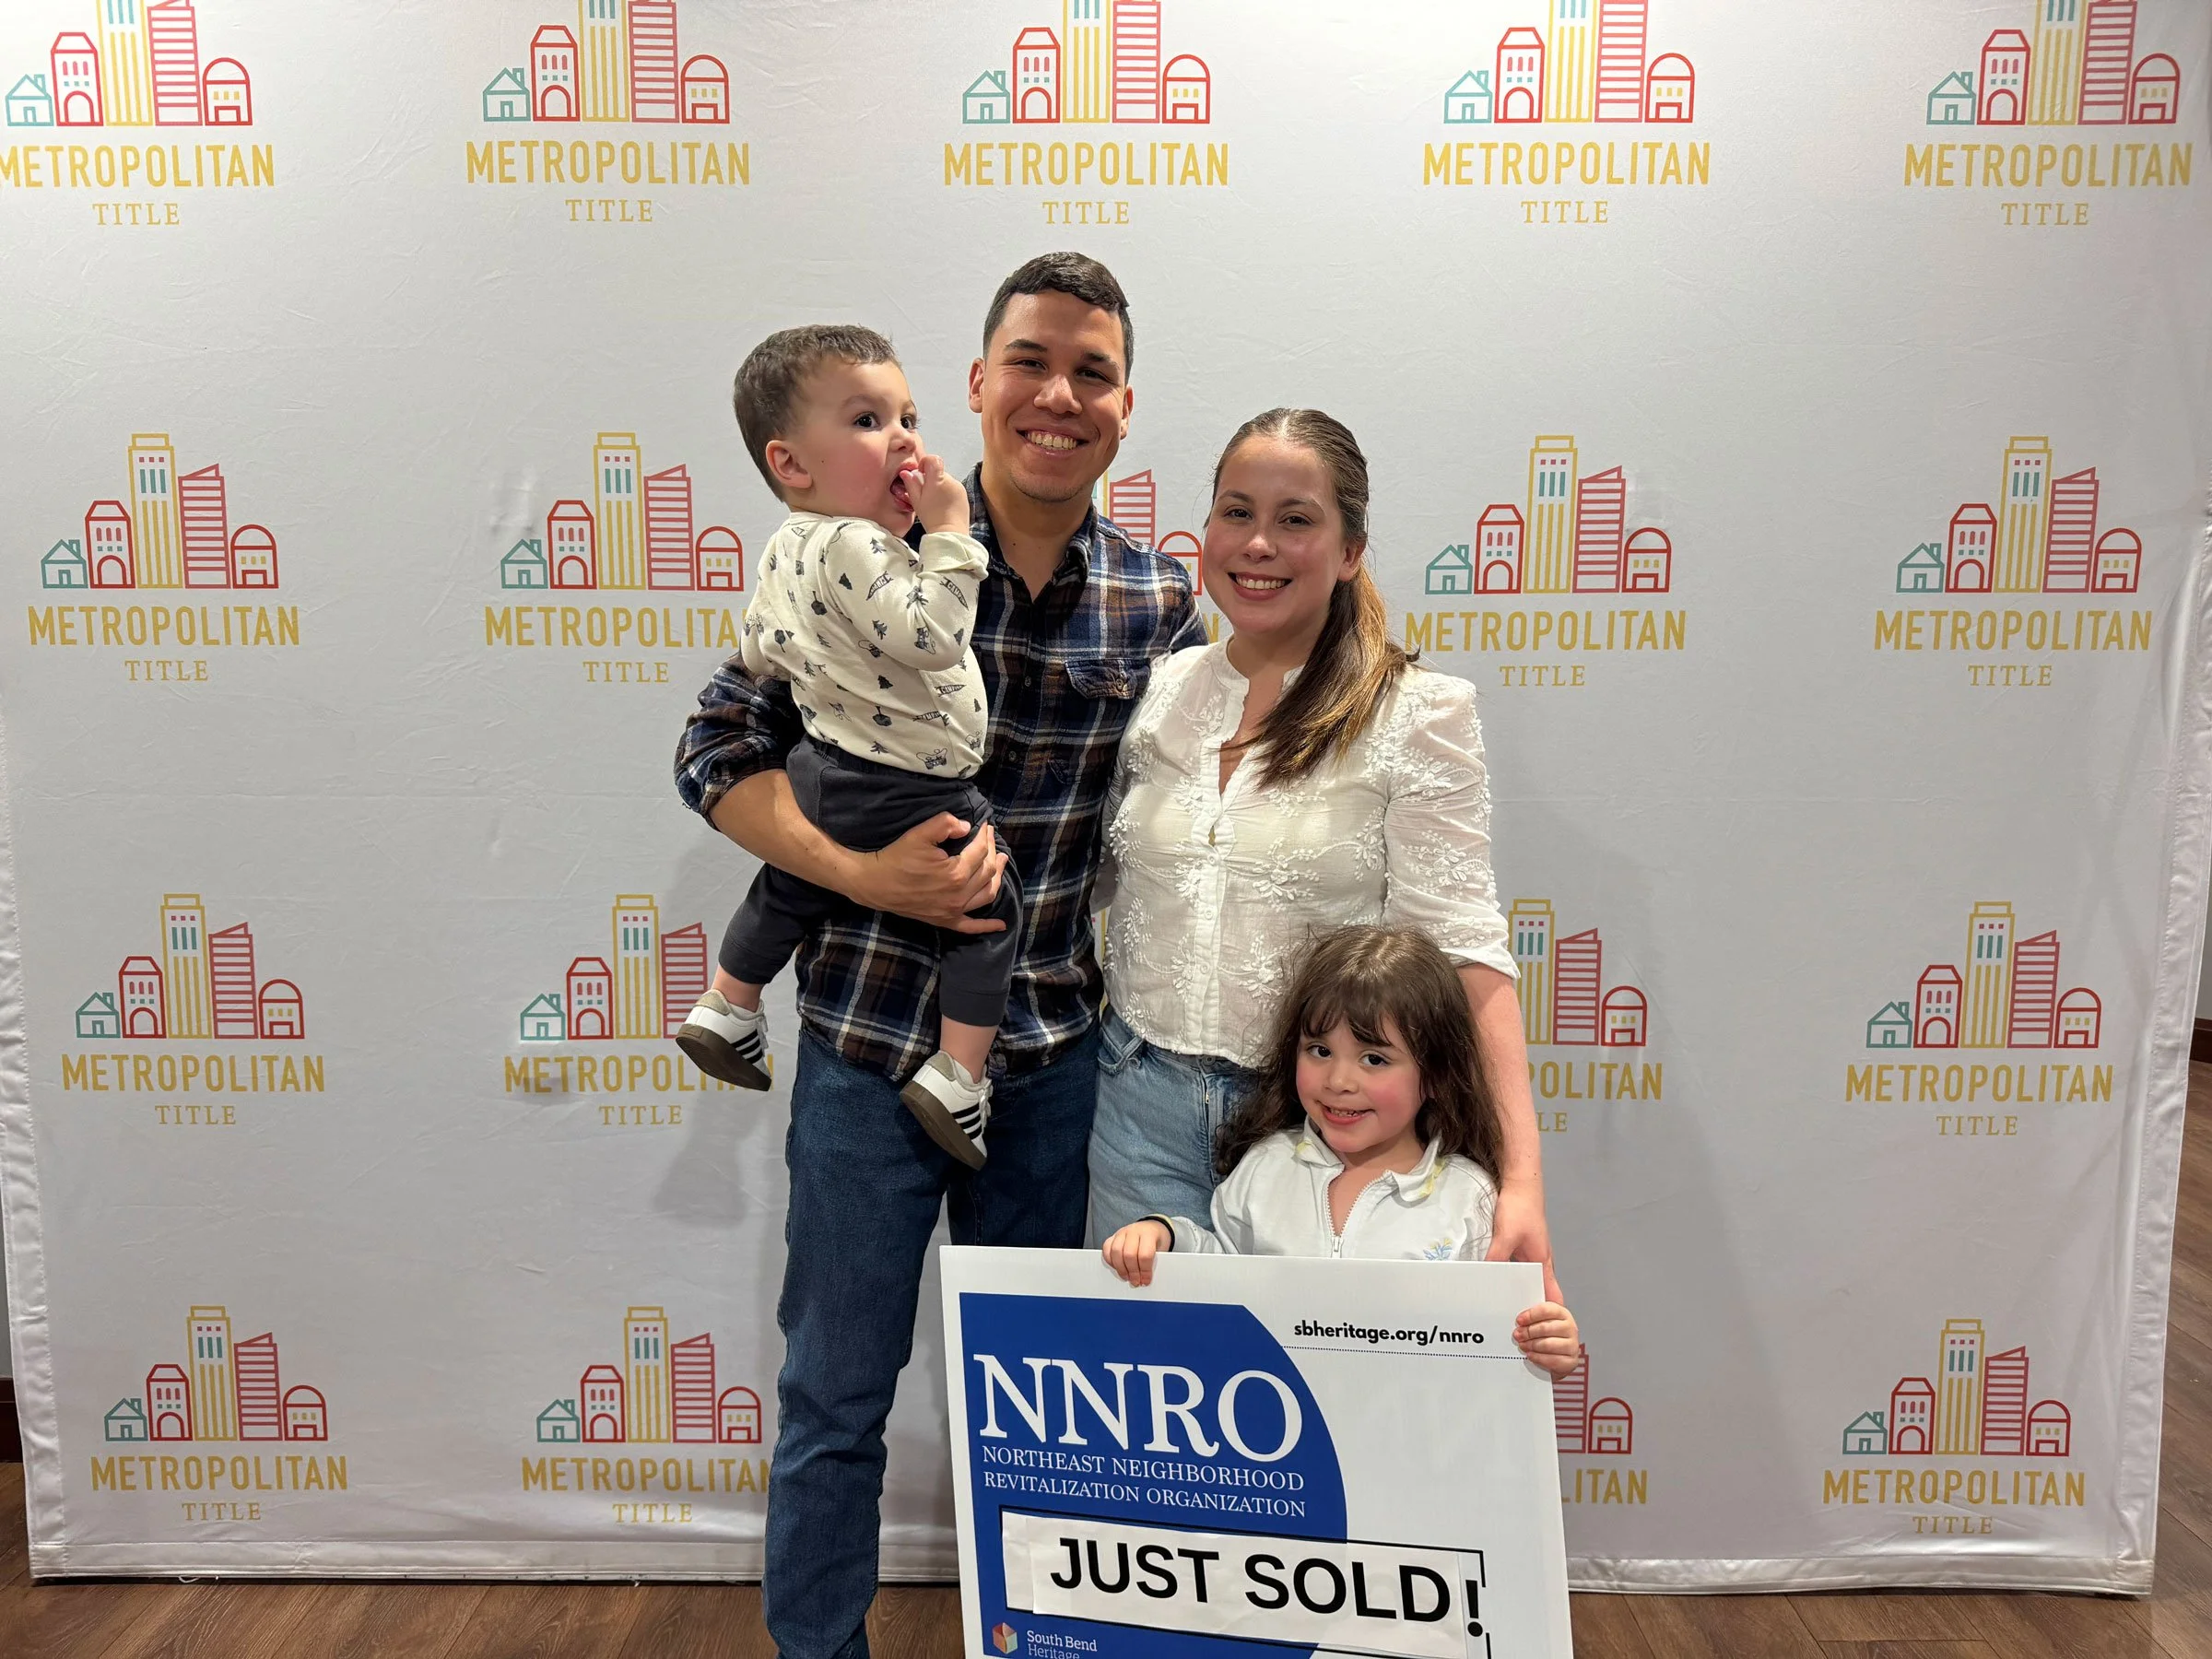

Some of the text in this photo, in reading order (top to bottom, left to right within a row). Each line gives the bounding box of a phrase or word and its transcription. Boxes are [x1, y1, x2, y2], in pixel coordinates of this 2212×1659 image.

[0, 145, 275, 187] METROPOLITAN
[467, 141, 750, 185] METROPOLITAN
[946, 143, 1229, 186] METROPOLITAN
[1425, 143, 1711, 186] METROPOLITAN
[1905, 145, 2193, 188] METROPOLITAN
[90, 201, 181, 227] TITLE
[564, 198, 653, 222] TITLE
[1041, 199, 1130, 226] TITLE
[1520, 200, 1608, 225] TITLE
[2001, 202, 2088, 227] TITLE
[29, 607, 300, 646] METROPOLITAN
[1405, 610, 1687, 652] METROPOLITAN
[1876, 611, 2152, 651] METROPOLITAN
[124, 659, 207, 682] TITLE
[582, 660, 670, 684] TITLE
[1498, 664, 1587, 688] TITLE
[1968, 664, 2052, 688] TITLE
[63, 1055, 325, 1092] METROPOLITAN
[1847, 1065, 2113, 1103] METROPOLITAN
[155, 1105, 233, 1125] TITLE
[598, 1105, 682, 1126] TITLE
[1938, 1114, 2018, 1135] TITLE
[1294, 1320, 1484, 1346] sbheritage.org/nnro
[973, 1354, 1302, 1462] NNRO
[92, 1456, 348, 1491] METROPOLITAN
[982, 1445, 1304, 1491] NORTHEAST NEIGHBORHOOD
[984, 1472, 1305, 1517] REVITALIZATION ORGANIZATION
[1824, 1470, 2086, 1507] METROPOLITAN
[182, 1502, 260, 1521] TITLE
[612, 1503, 691, 1524] TITLE
[1915, 1515, 1991, 1534] TITLE
[1050, 1537, 1219, 1604] JUST
[1027, 1630, 1098, 1652] South Bend
[1028, 1643, 1080, 1659] Heritage
